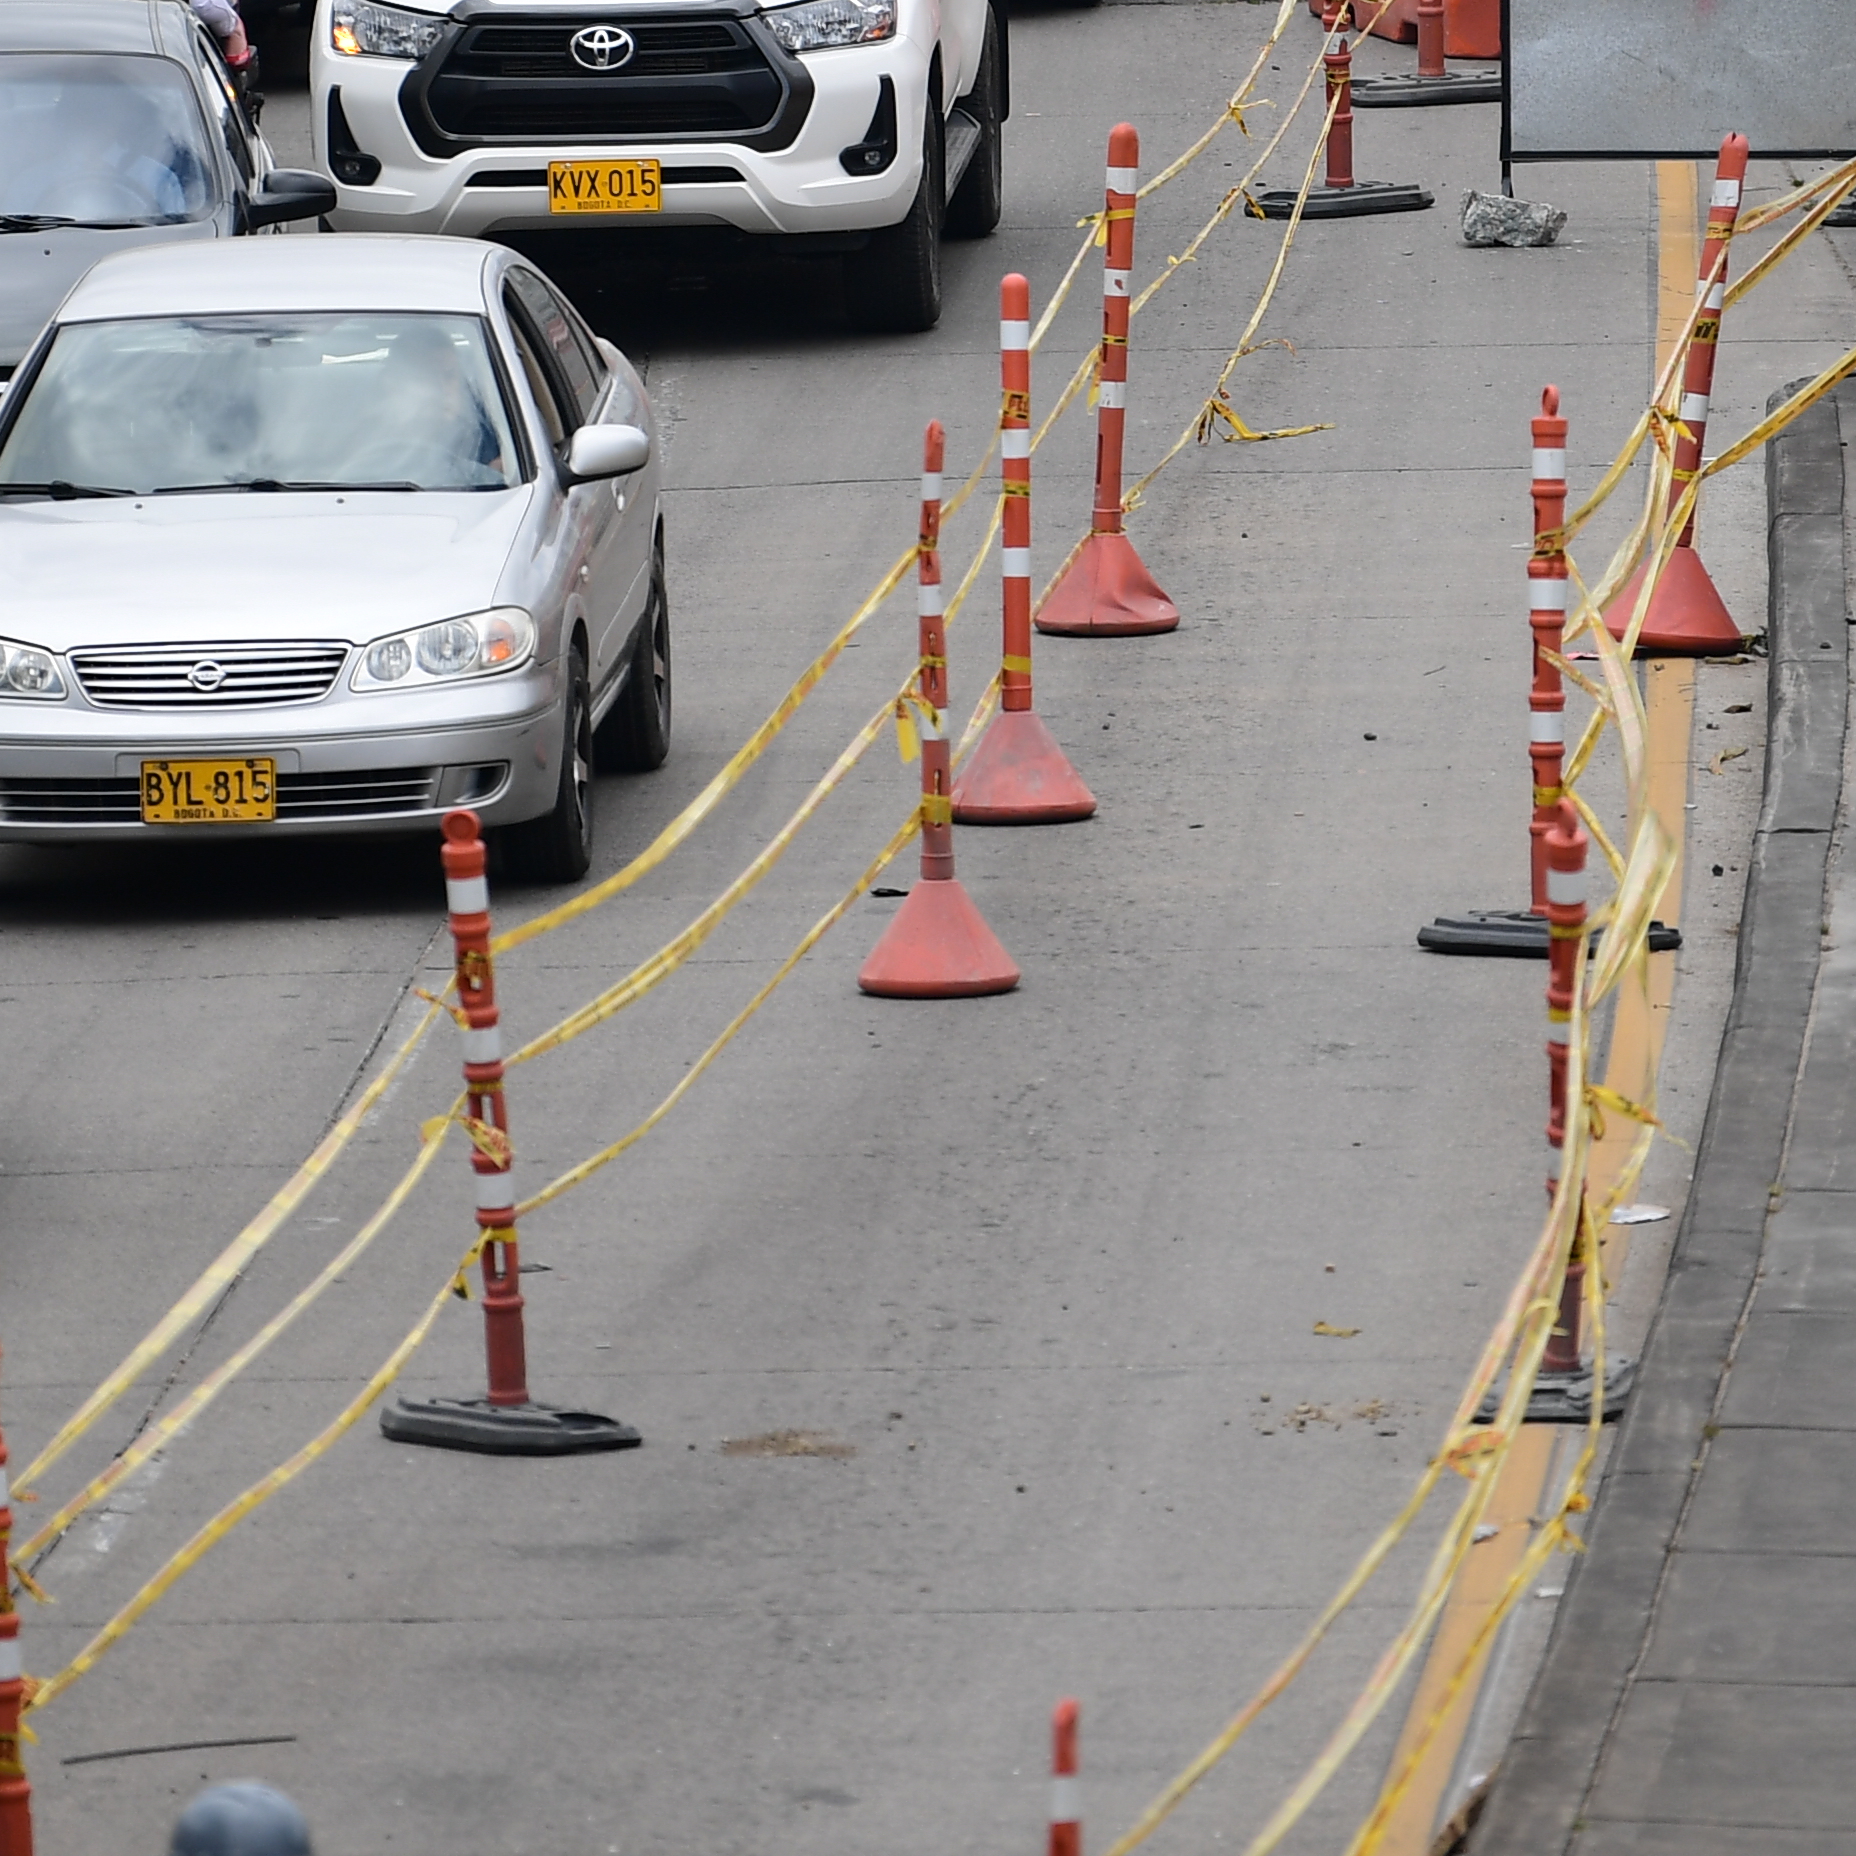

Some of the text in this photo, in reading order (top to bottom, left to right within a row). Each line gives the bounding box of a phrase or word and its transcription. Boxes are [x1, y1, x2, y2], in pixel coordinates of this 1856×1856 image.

[552, 169, 656, 199] KVX 015
[577, 200, 612, 210] BOGOTA
[145, 770, 271, 806] BYL 815
